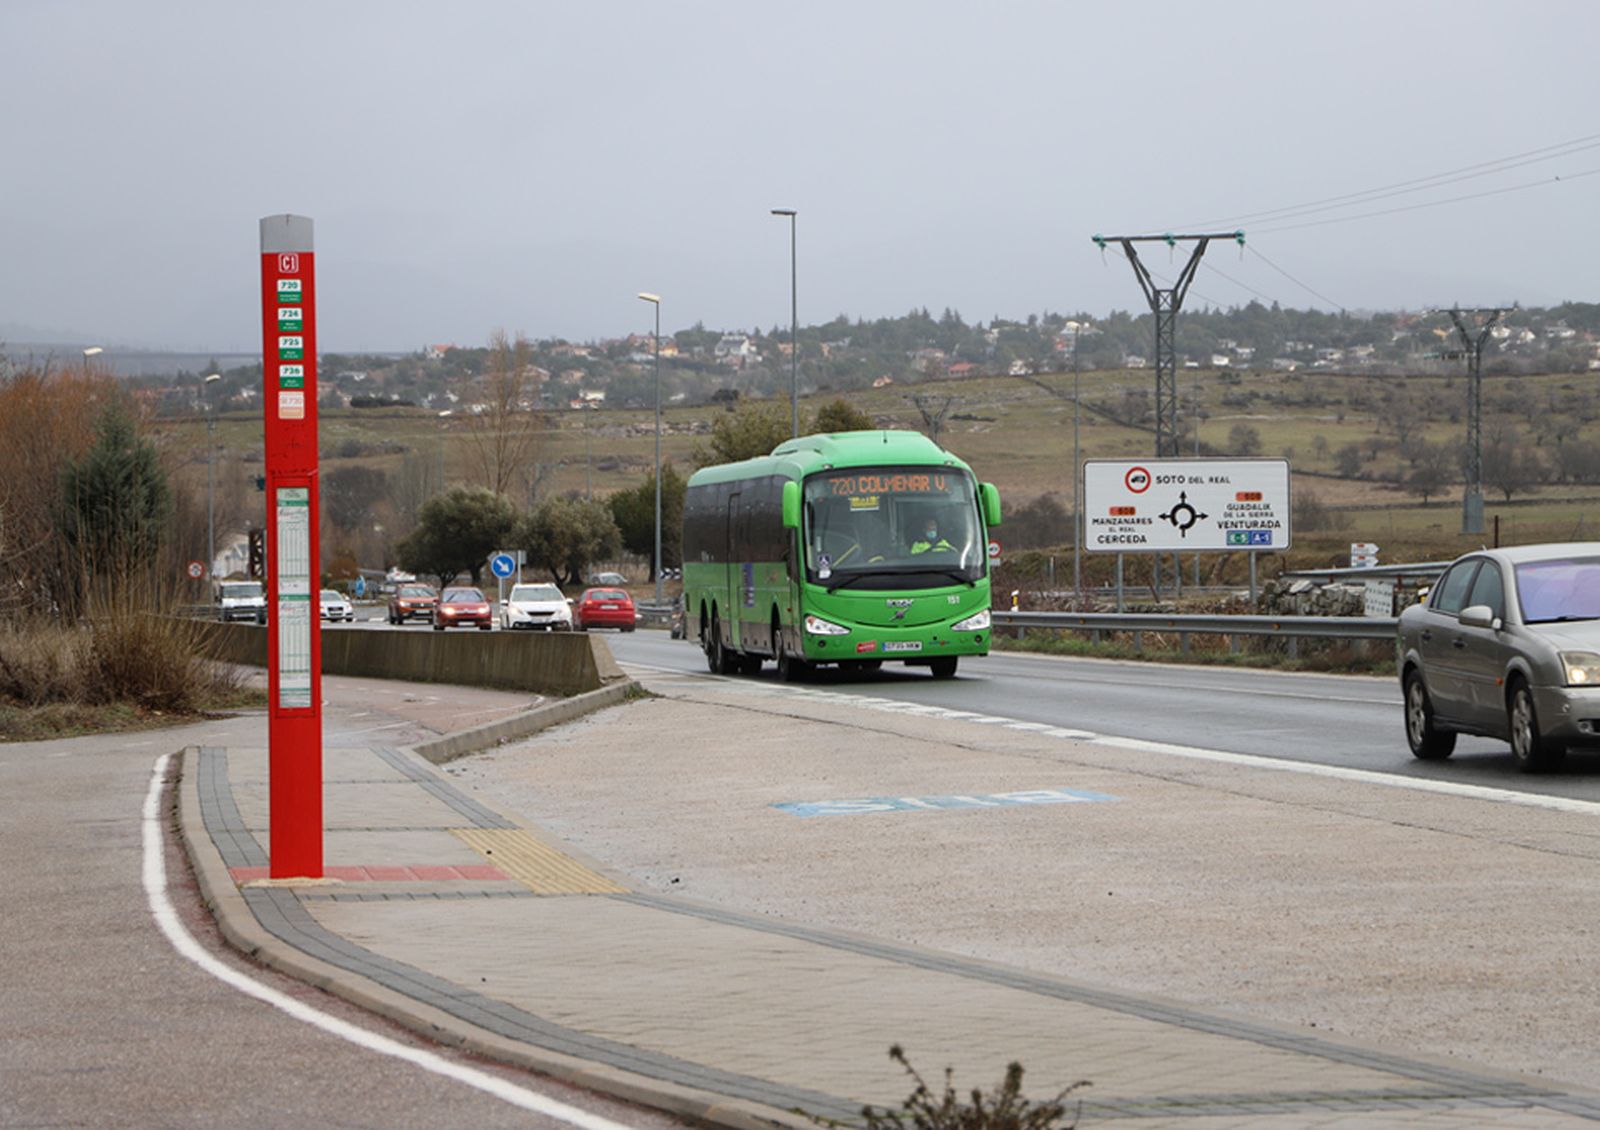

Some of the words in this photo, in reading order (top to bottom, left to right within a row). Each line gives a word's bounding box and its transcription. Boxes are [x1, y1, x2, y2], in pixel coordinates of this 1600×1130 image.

[282, 309, 299, 318] 724
[282, 338, 300, 346] 725
[1155, 475, 1186, 484] SOTO
[1188, 476, 1205, 484] DEL
[1208, 476, 1231, 484] REAL
[829, 478, 856, 495] 720
[858, 475, 931, 493] COLMENAR
[1226, 503, 1272, 511] GUADALIX
[1092, 517, 1153, 526] MANZANARES
[1216, 520, 1281, 530] VENTURADA
[1097, 534, 1147, 544] CERCEDA
